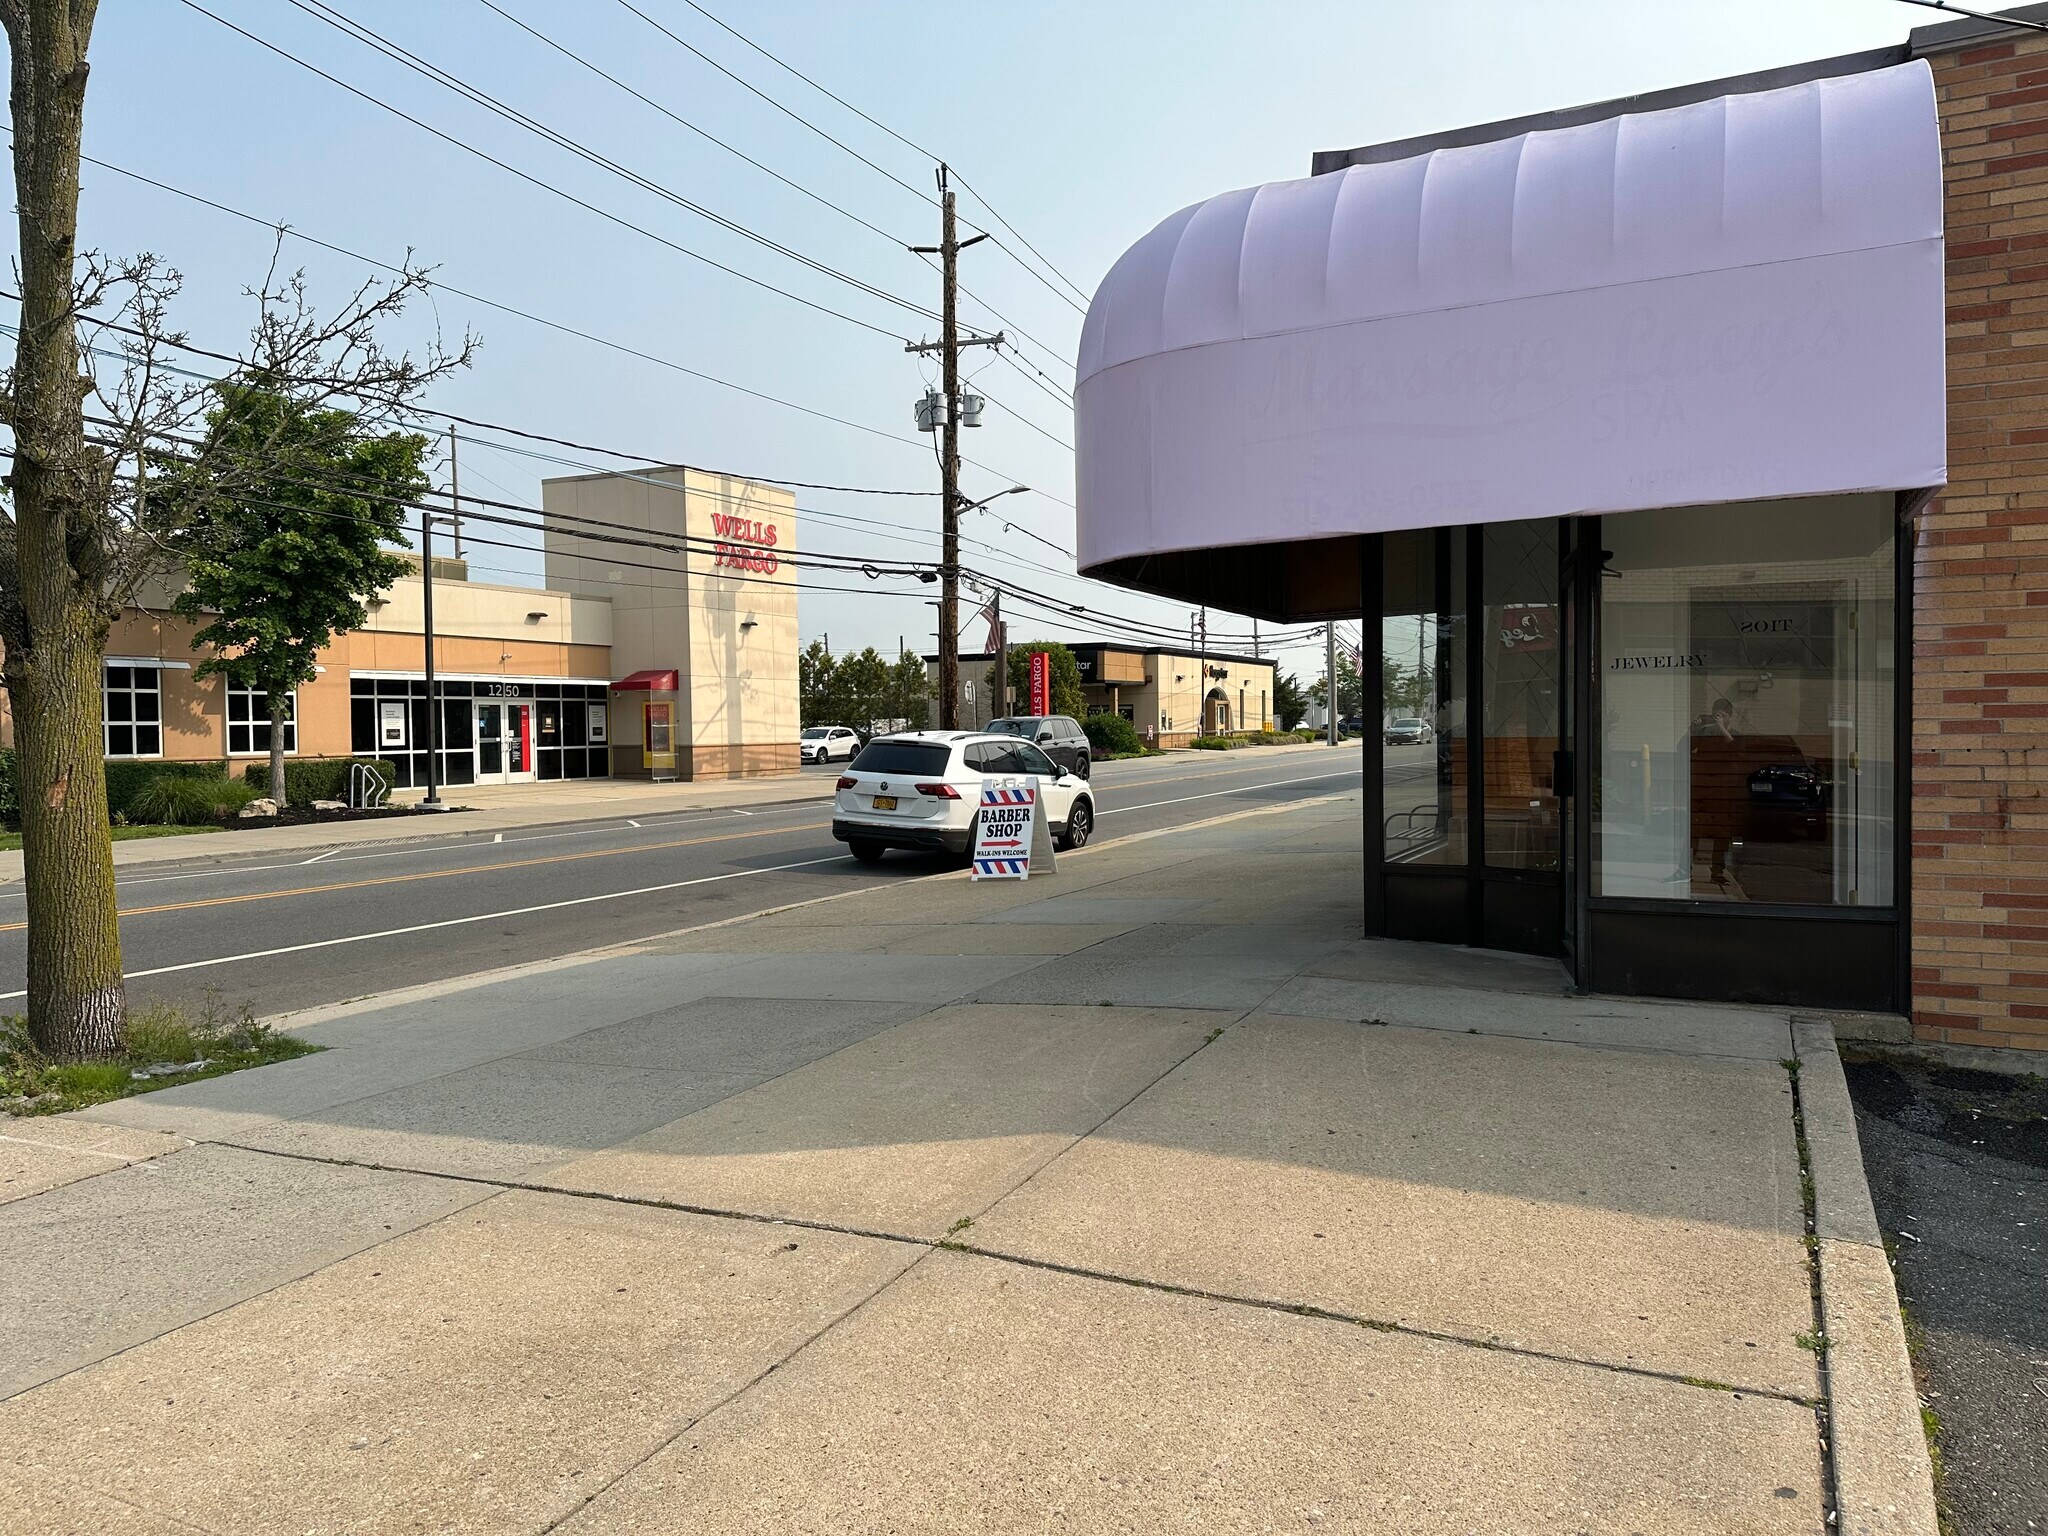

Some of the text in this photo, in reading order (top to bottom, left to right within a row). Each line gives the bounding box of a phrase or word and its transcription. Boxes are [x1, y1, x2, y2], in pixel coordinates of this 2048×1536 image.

[1248, 334, 1566, 419] Massage
[1591, 384, 1692, 445] SPA
[711, 513, 777, 547] WELLS
[713, 543, 778, 575] FARGO
[1610, 654, 1708, 670] JEWELRY
[488, 684, 520, 697] 1250
[1033, 657, 1043, 717] LLS FARGO
[980, 808, 1030, 823] BARBER
[986, 823, 1022, 837] SHOP
